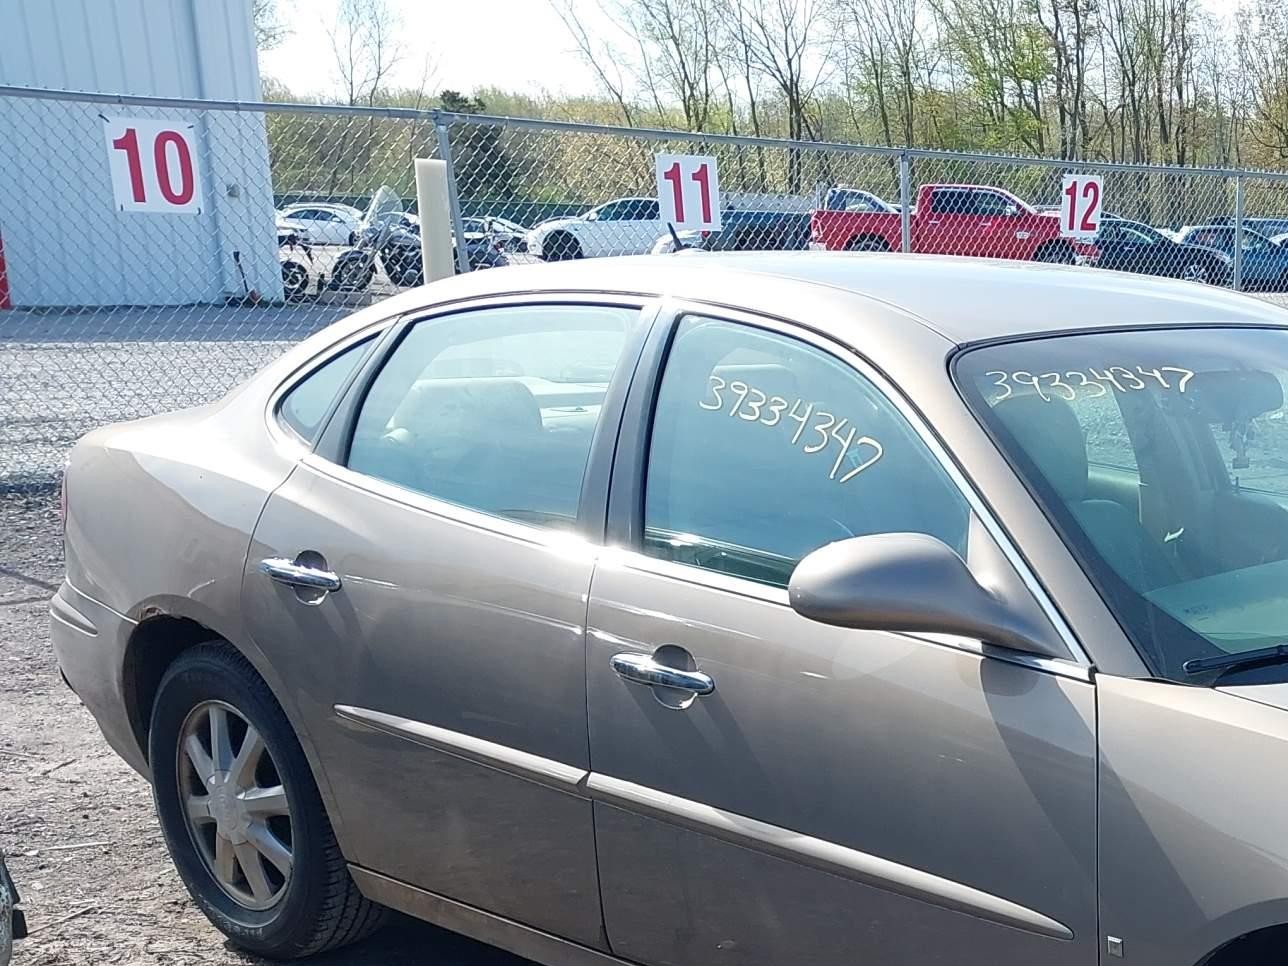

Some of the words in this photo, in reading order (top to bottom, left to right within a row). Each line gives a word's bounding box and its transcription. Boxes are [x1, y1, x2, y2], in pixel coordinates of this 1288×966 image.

[113, 128, 194, 205] 10
[664, 162, 712, 224] 11
[1065, 180, 1100, 231] 12
[985, 365, 1195, 402] 39334347
[698, 375, 884, 483] 39334347
